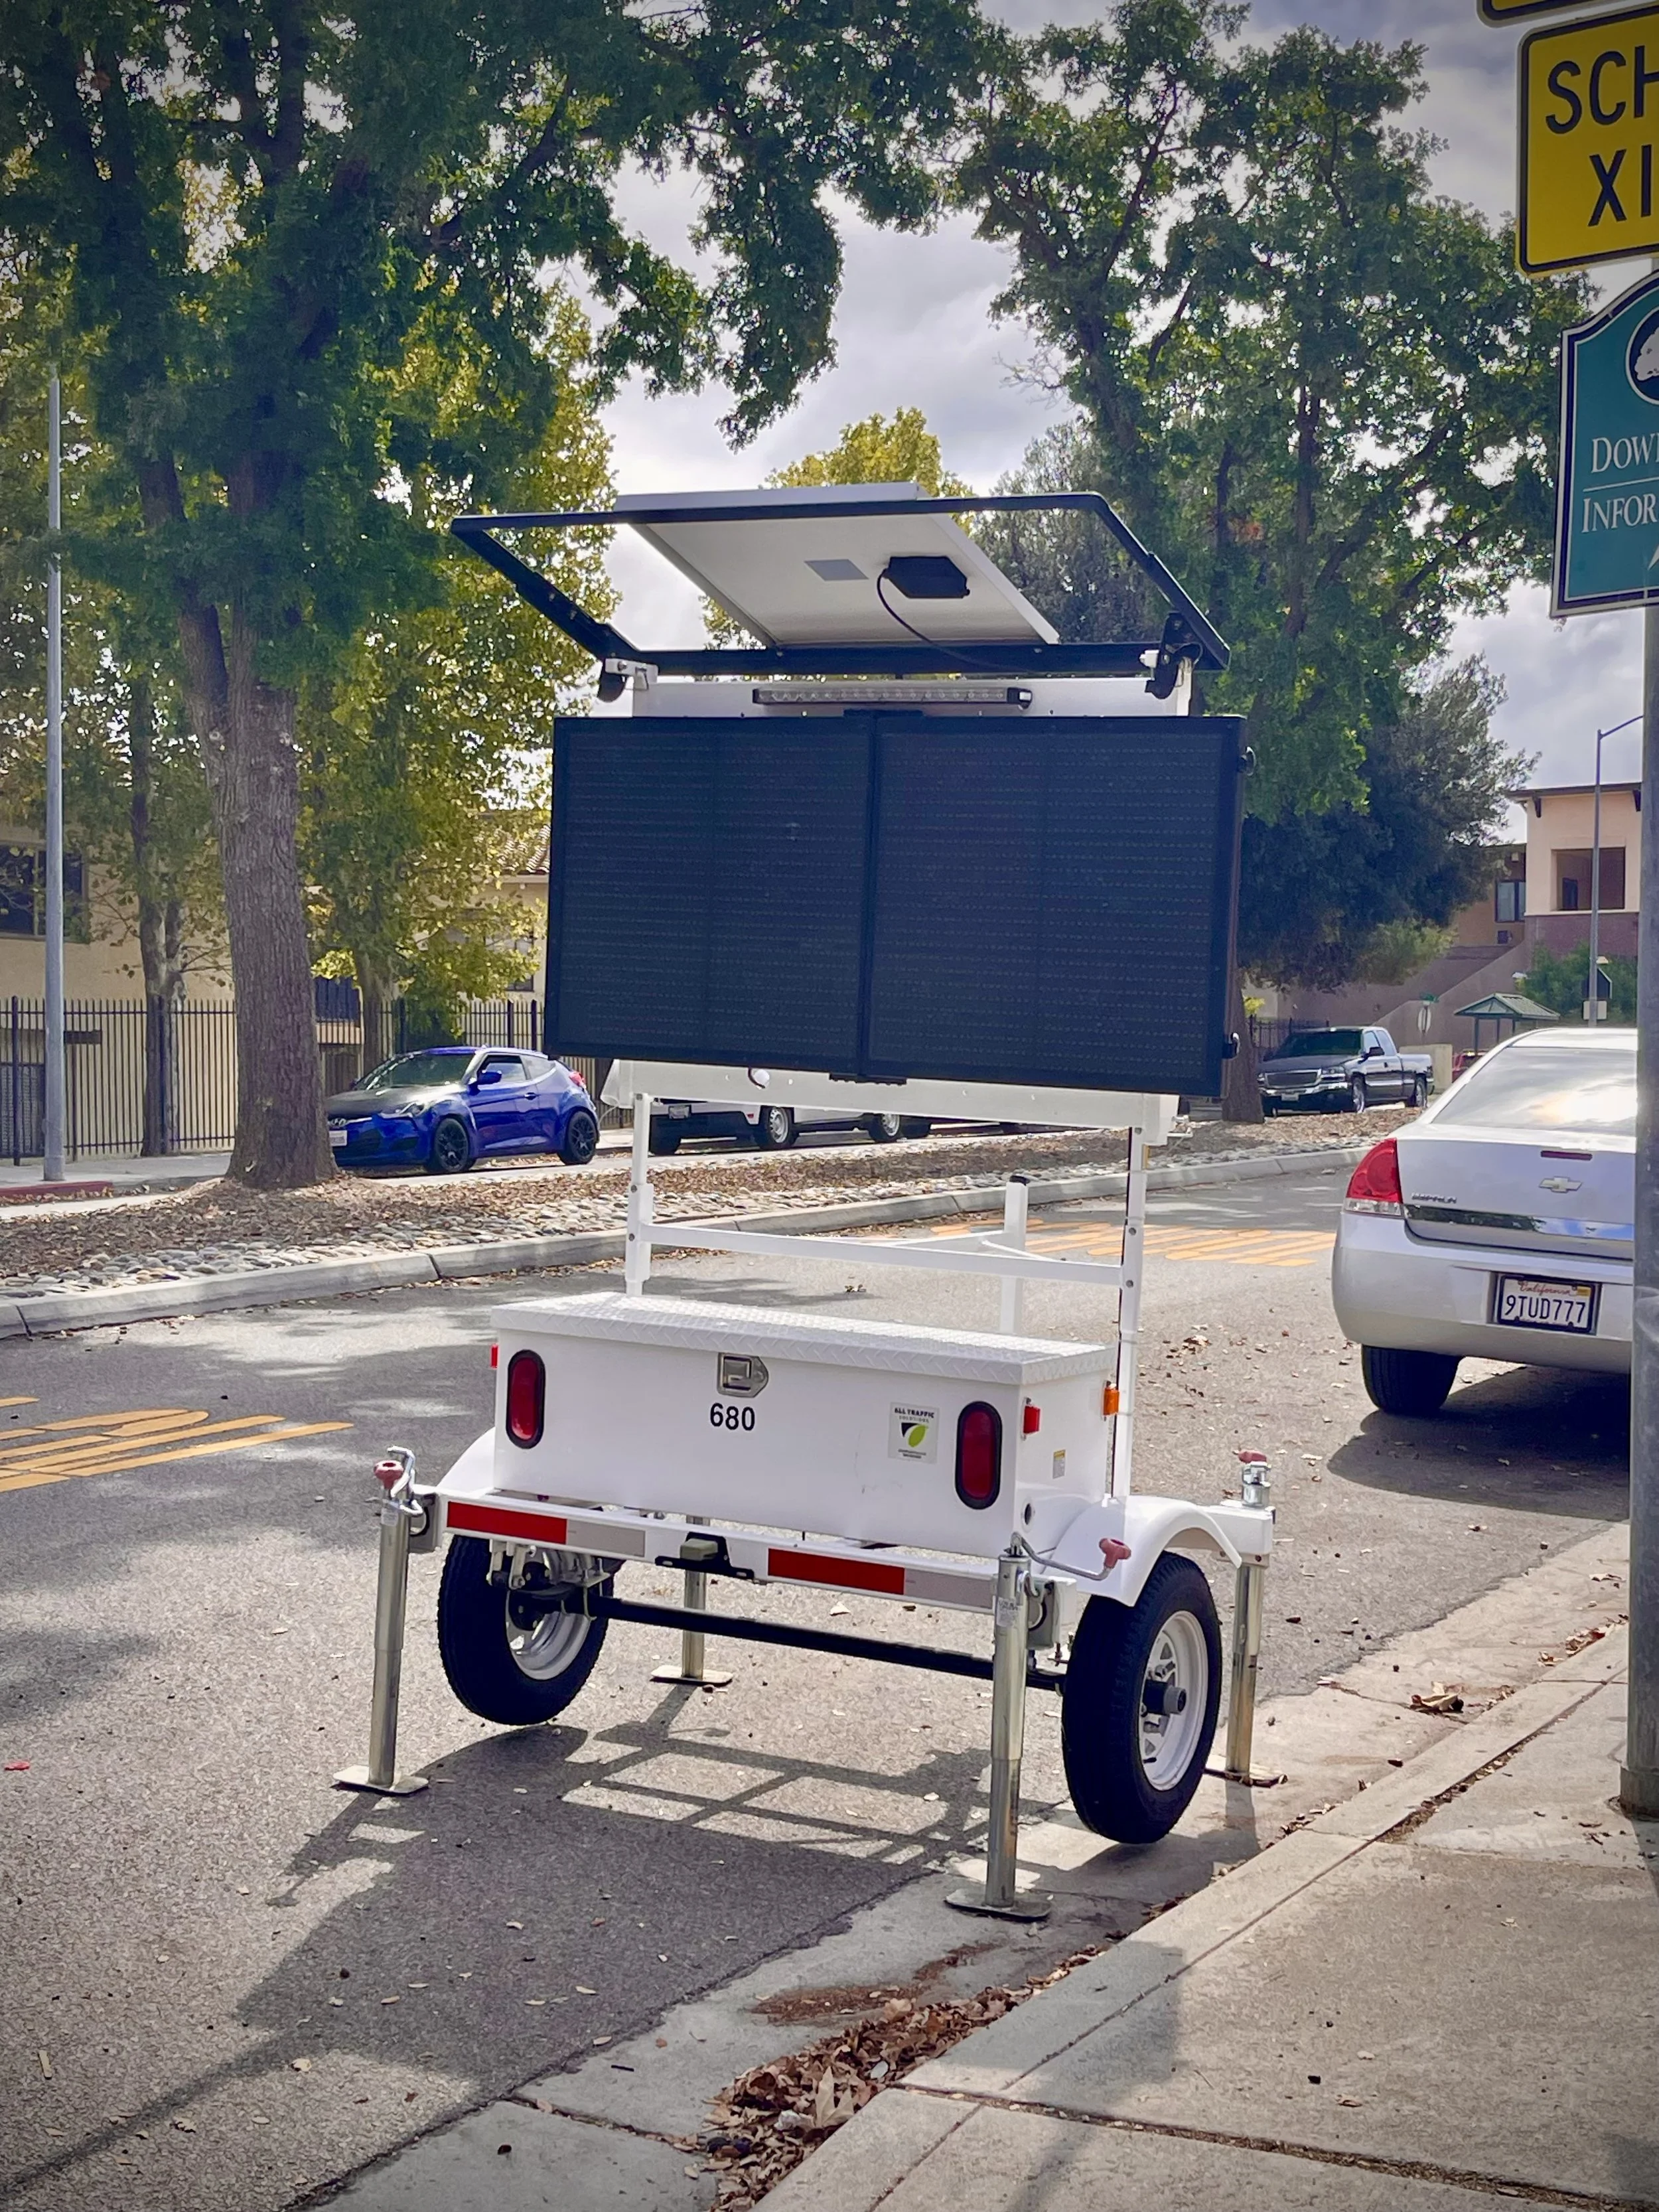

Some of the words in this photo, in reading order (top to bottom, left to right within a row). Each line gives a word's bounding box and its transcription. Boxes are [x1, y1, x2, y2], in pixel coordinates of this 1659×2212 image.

[1546, 45, 1659, 134] SCH
[1587, 144, 1652, 226] XI
[1591, 433, 1659, 473] DOW
[1505, 1295, 1586, 1323] 9TUD777
[710, 1403, 755, 1431] 680
[907, 1409, 934, 1418] TRAFFIC
